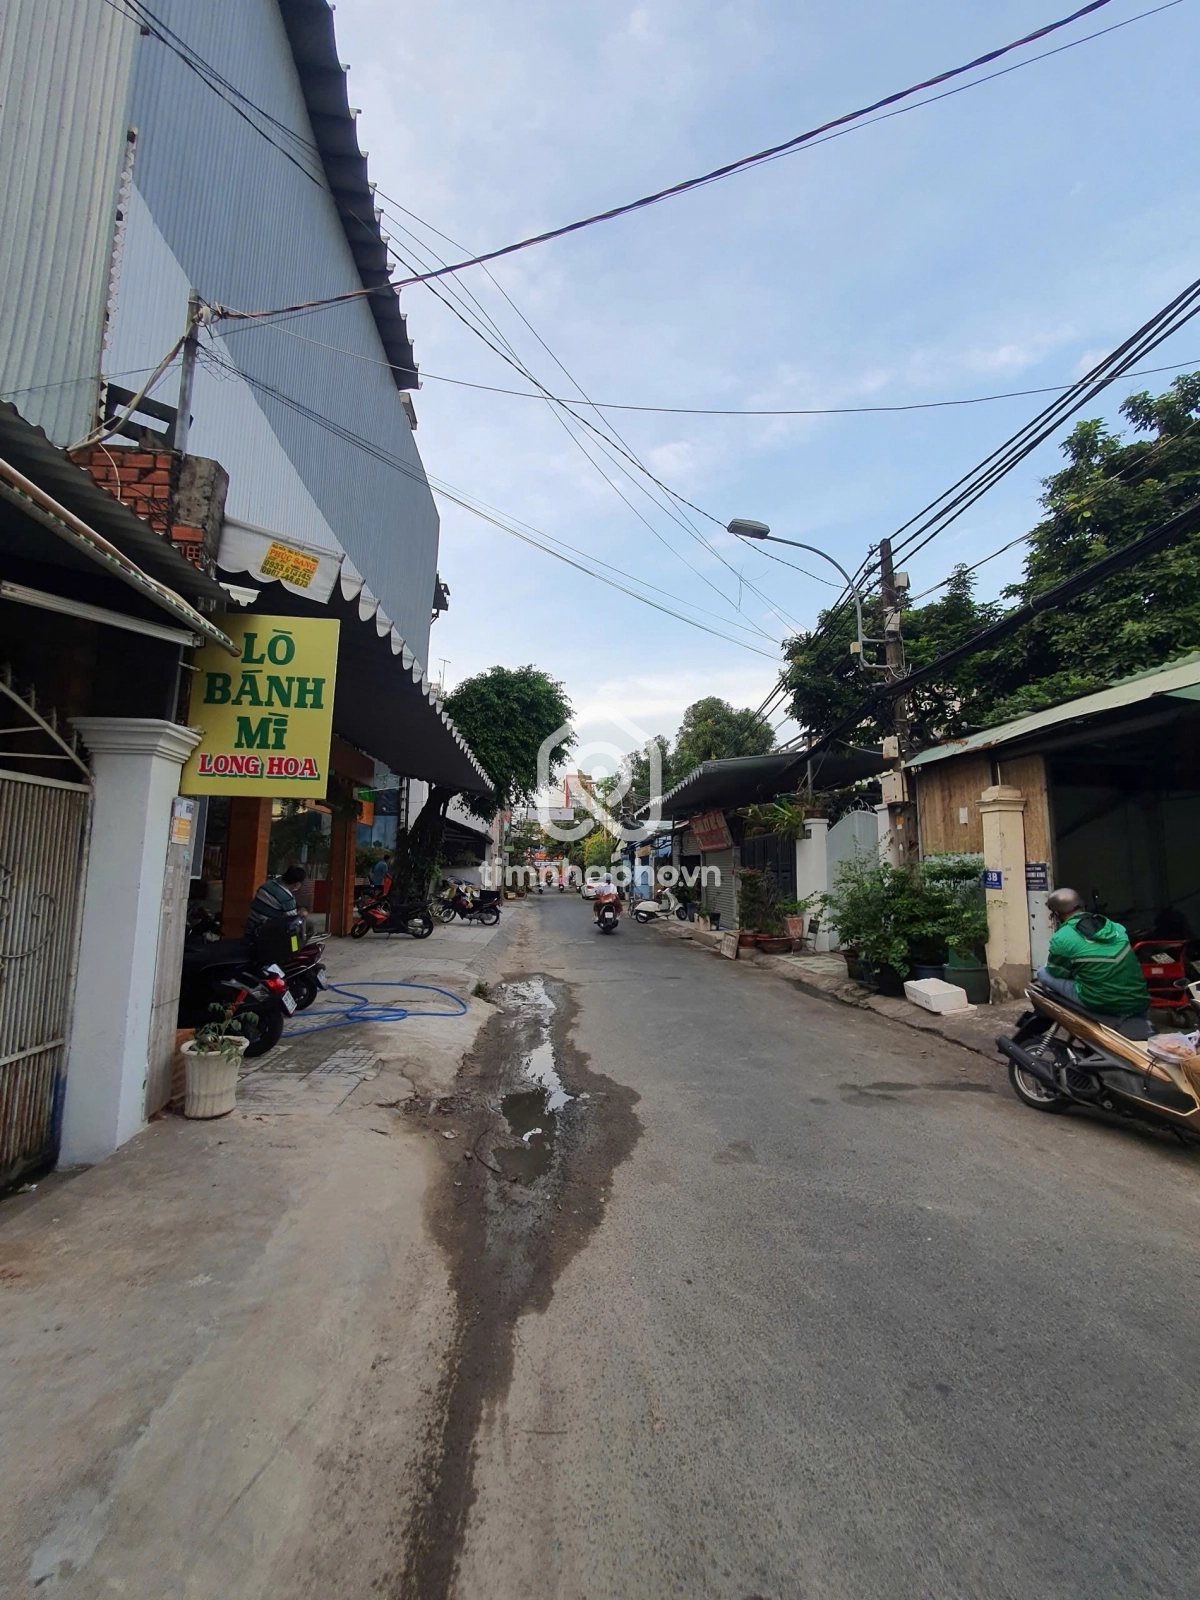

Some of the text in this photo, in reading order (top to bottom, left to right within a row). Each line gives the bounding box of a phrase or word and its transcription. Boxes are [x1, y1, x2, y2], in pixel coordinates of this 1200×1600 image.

[269, 549, 292, 562] PHÚC
[293, 557, 316, 571] SANG
[241, 629, 296, 666] LÒ
[203, 670, 326, 710] BÁNH
[234, 712, 289, 750] MÌ
[198, 753, 321, 780] LONG HOA
[987, 872, 998, 881] 3B
